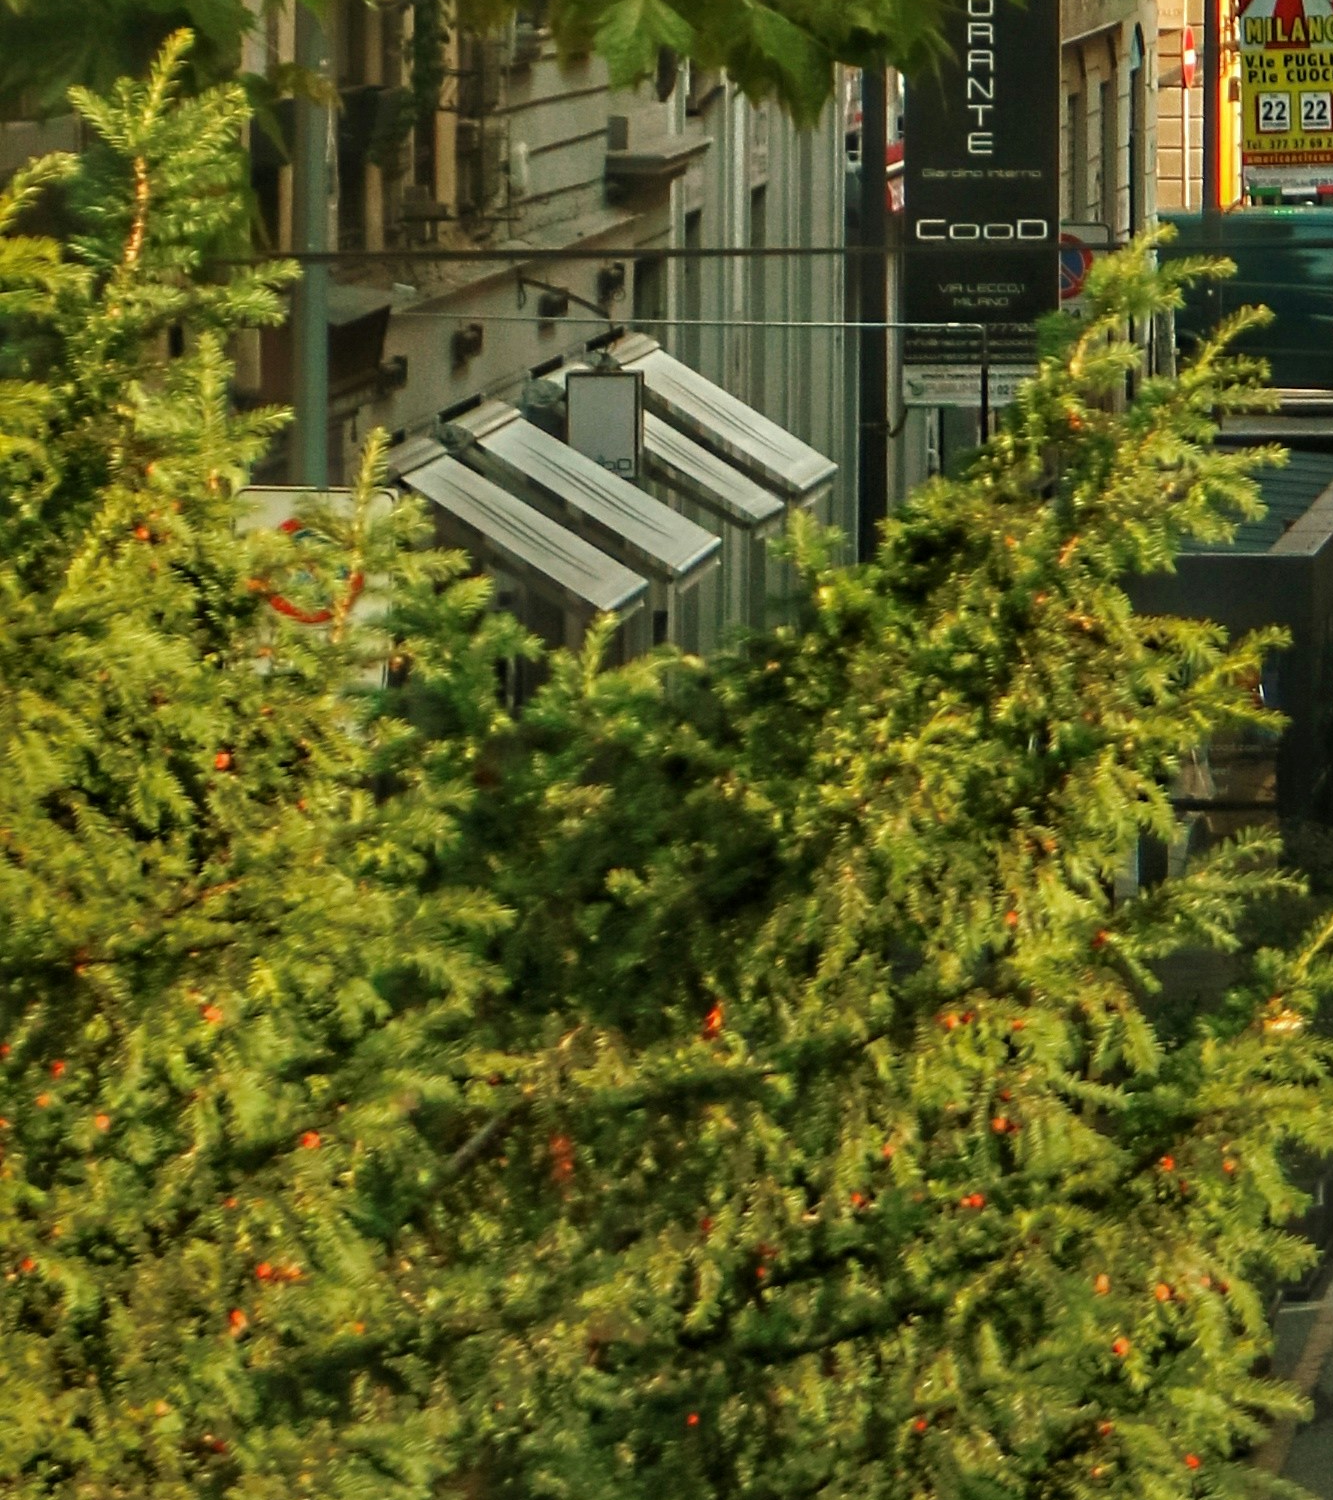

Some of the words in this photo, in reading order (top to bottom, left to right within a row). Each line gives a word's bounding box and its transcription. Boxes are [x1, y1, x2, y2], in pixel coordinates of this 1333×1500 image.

[1245, 55, 1275, 68] V.le
[1248, 70, 1278, 83] P.le
[1262, 100, 1287, 121] 22
[1303, 100, 1328, 120] 22
